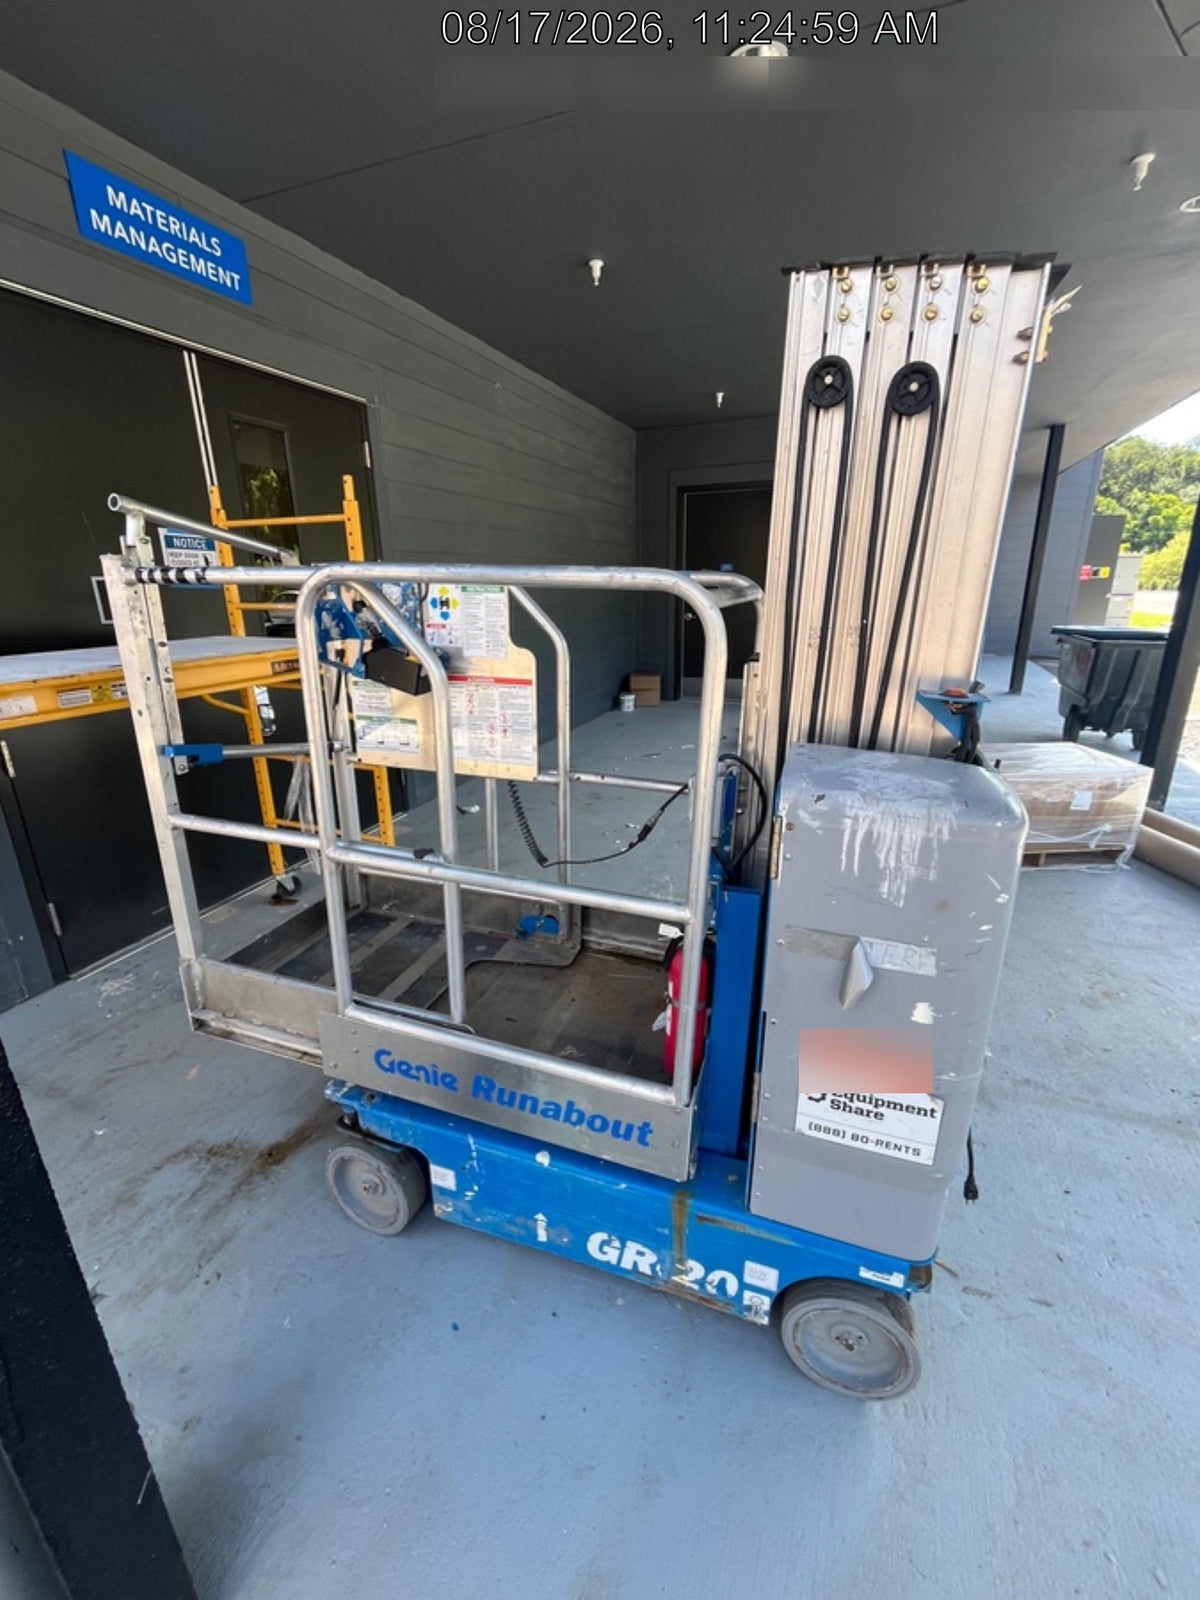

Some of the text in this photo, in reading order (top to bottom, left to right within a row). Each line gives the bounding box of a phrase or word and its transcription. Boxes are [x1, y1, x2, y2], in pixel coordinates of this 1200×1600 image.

[106, 184, 222, 257] MATERIALS
[89, 207, 240, 291] MANAGEMENT
[173, 537, 208, 550] NOTICE
[373, 1048, 654, 1147] Genie Runabout
[830, 1099, 885, 1121] Share
[808, 1121, 846, 1140] (888)
